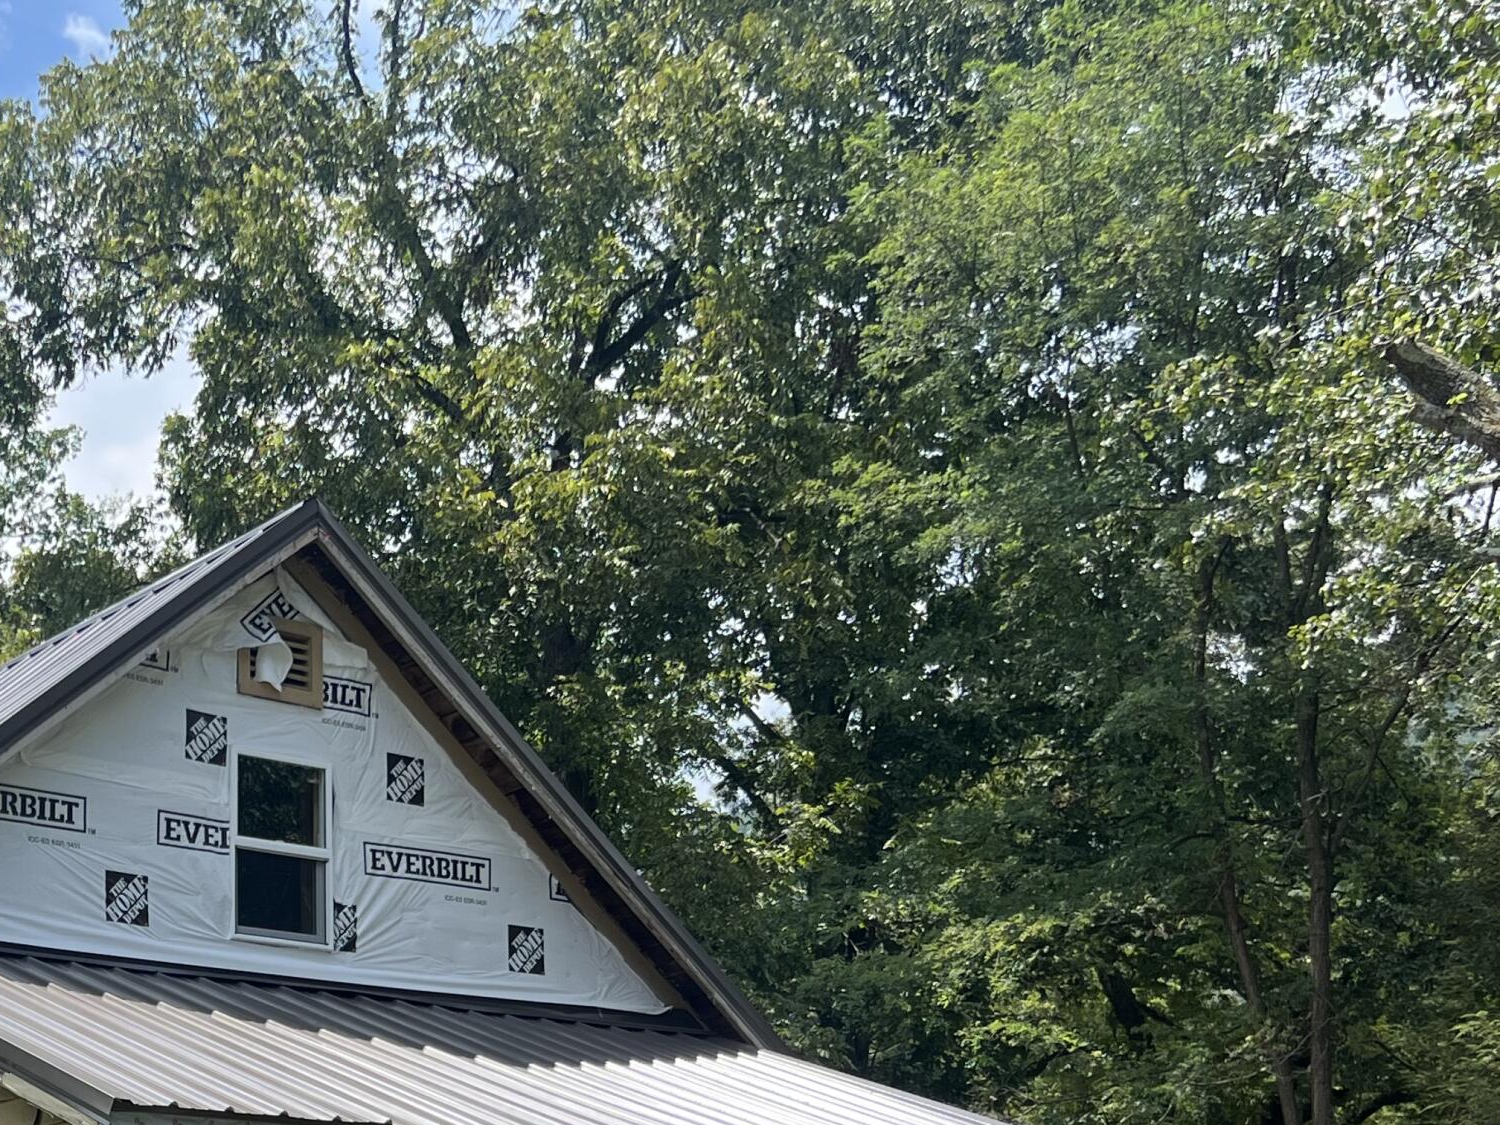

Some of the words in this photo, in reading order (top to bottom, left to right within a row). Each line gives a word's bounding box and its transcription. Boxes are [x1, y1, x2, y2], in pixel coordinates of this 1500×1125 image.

[185, 714, 228, 761] HOME
[190, 716, 207, 734] THE
[387, 757, 424, 802] HOME
[109, 876, 128, 897] THE
[370, 849, 485, 884] EVERBILT
[105, 875, 149, 922] HOME
[508, 928, 543, 973] HOME
[512, 930, 527, 949] THE
